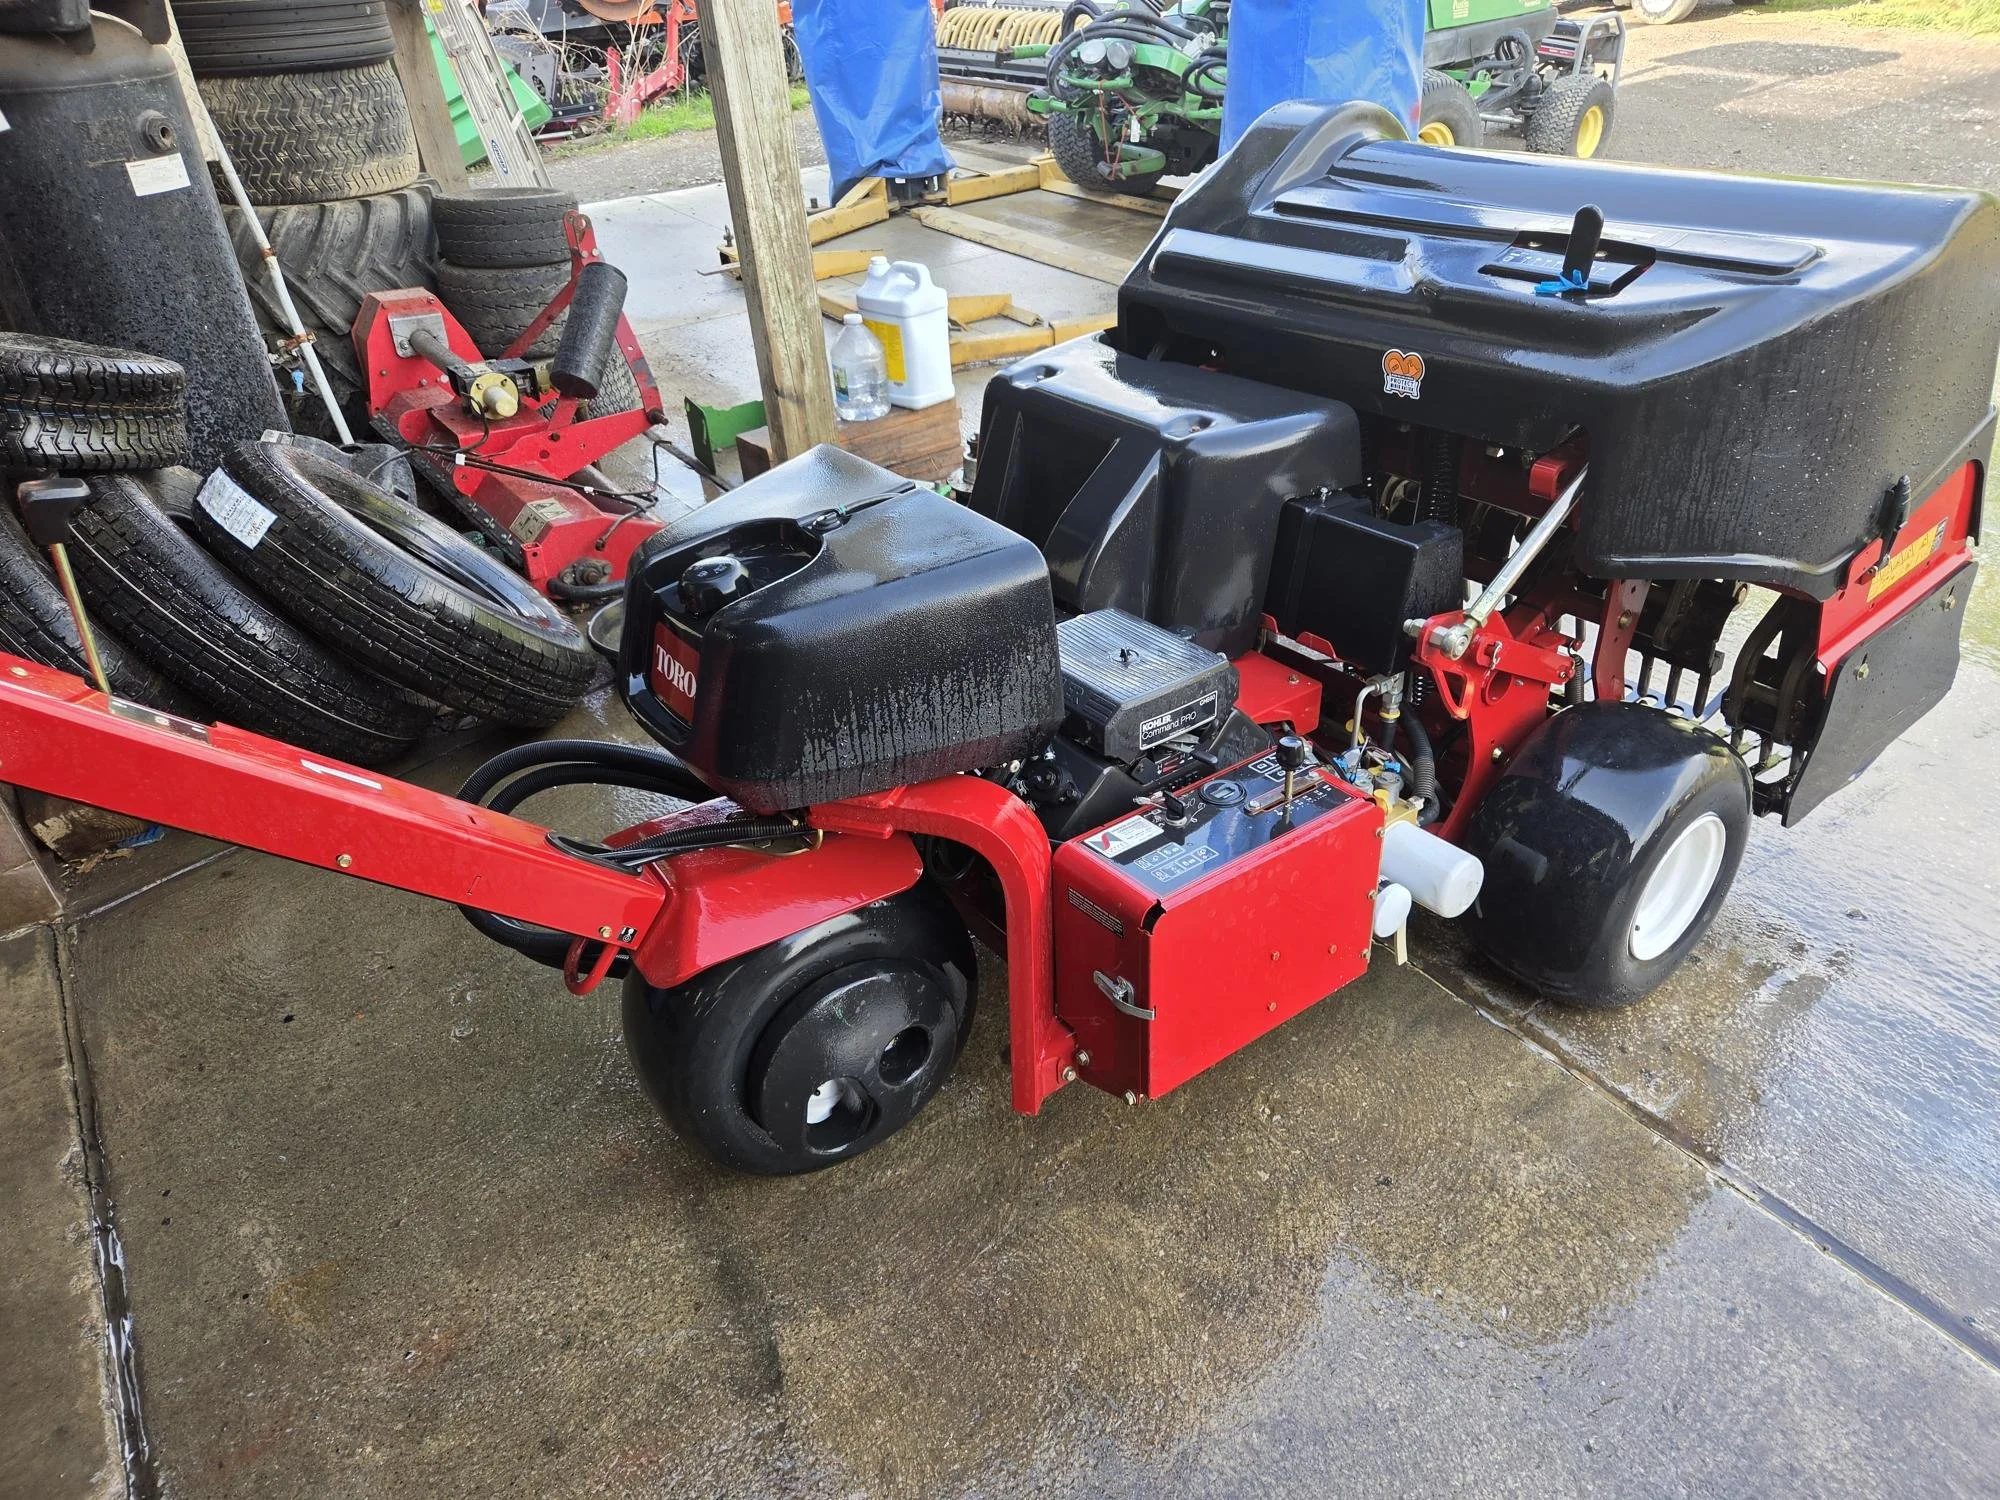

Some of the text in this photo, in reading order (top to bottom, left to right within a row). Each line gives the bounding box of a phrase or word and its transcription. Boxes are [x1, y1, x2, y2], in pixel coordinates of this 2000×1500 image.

[656, 644, 697, 698] TORO
[1142, 714, 1173, 732] KOHLER
[1142, 718, 1180, 740] Command
[1180, 711, 1197, 724] PRO
